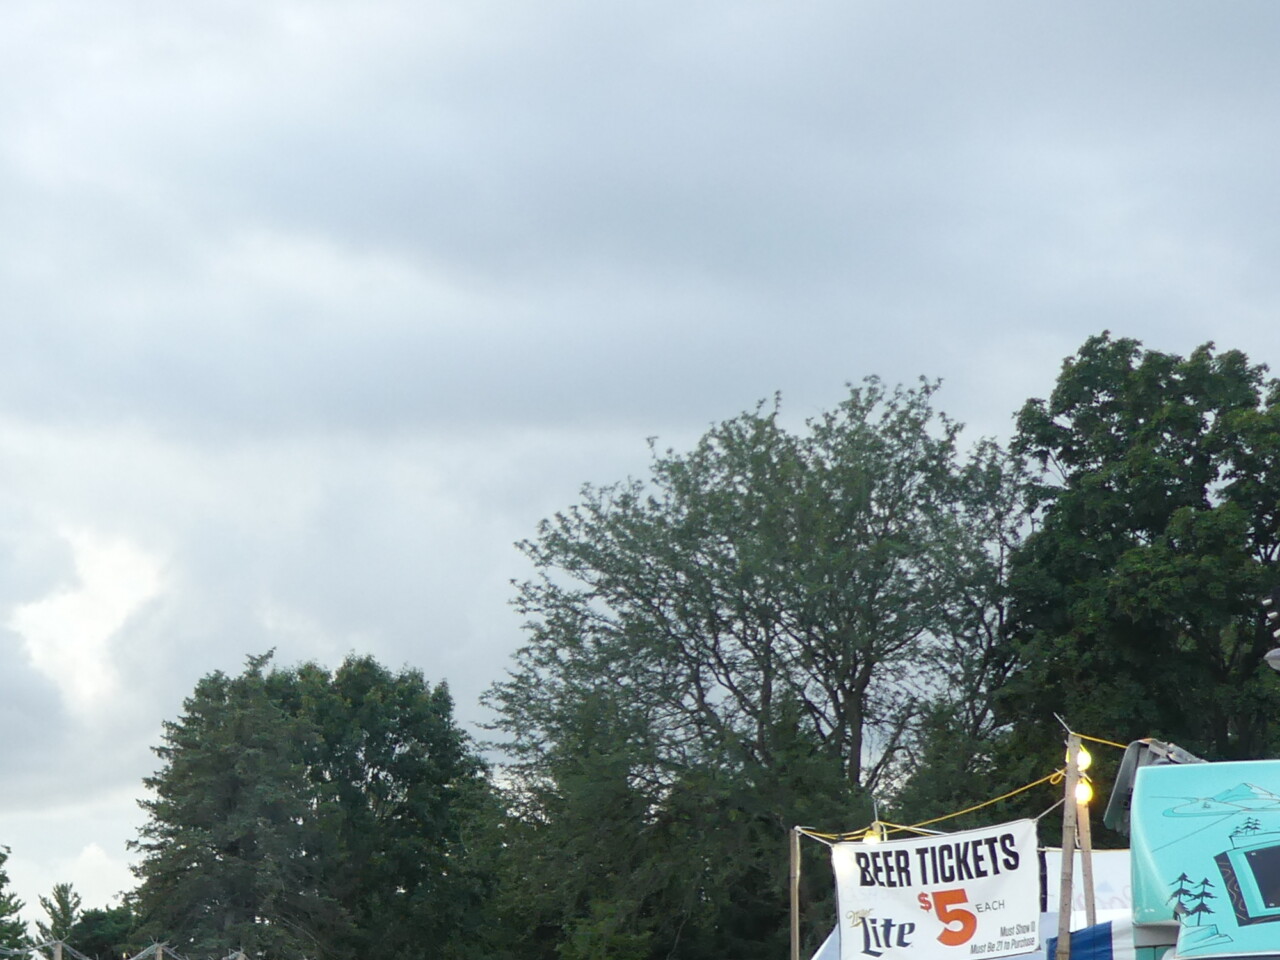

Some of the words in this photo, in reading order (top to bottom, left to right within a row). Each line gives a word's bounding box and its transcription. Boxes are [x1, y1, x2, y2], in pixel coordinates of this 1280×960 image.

[855, 849, 912, 887] BEER
[915, 833, 1020, 885] TICKETS
[859, 916, 916, 958] Lite
[917, 888, 978, 947] $5
[976, 900, 1006, 913] EACH
[1000, 926, 1015, 937] Must
[970, 944, 986, 954] Must
[987, 942, 995, 953] Be
